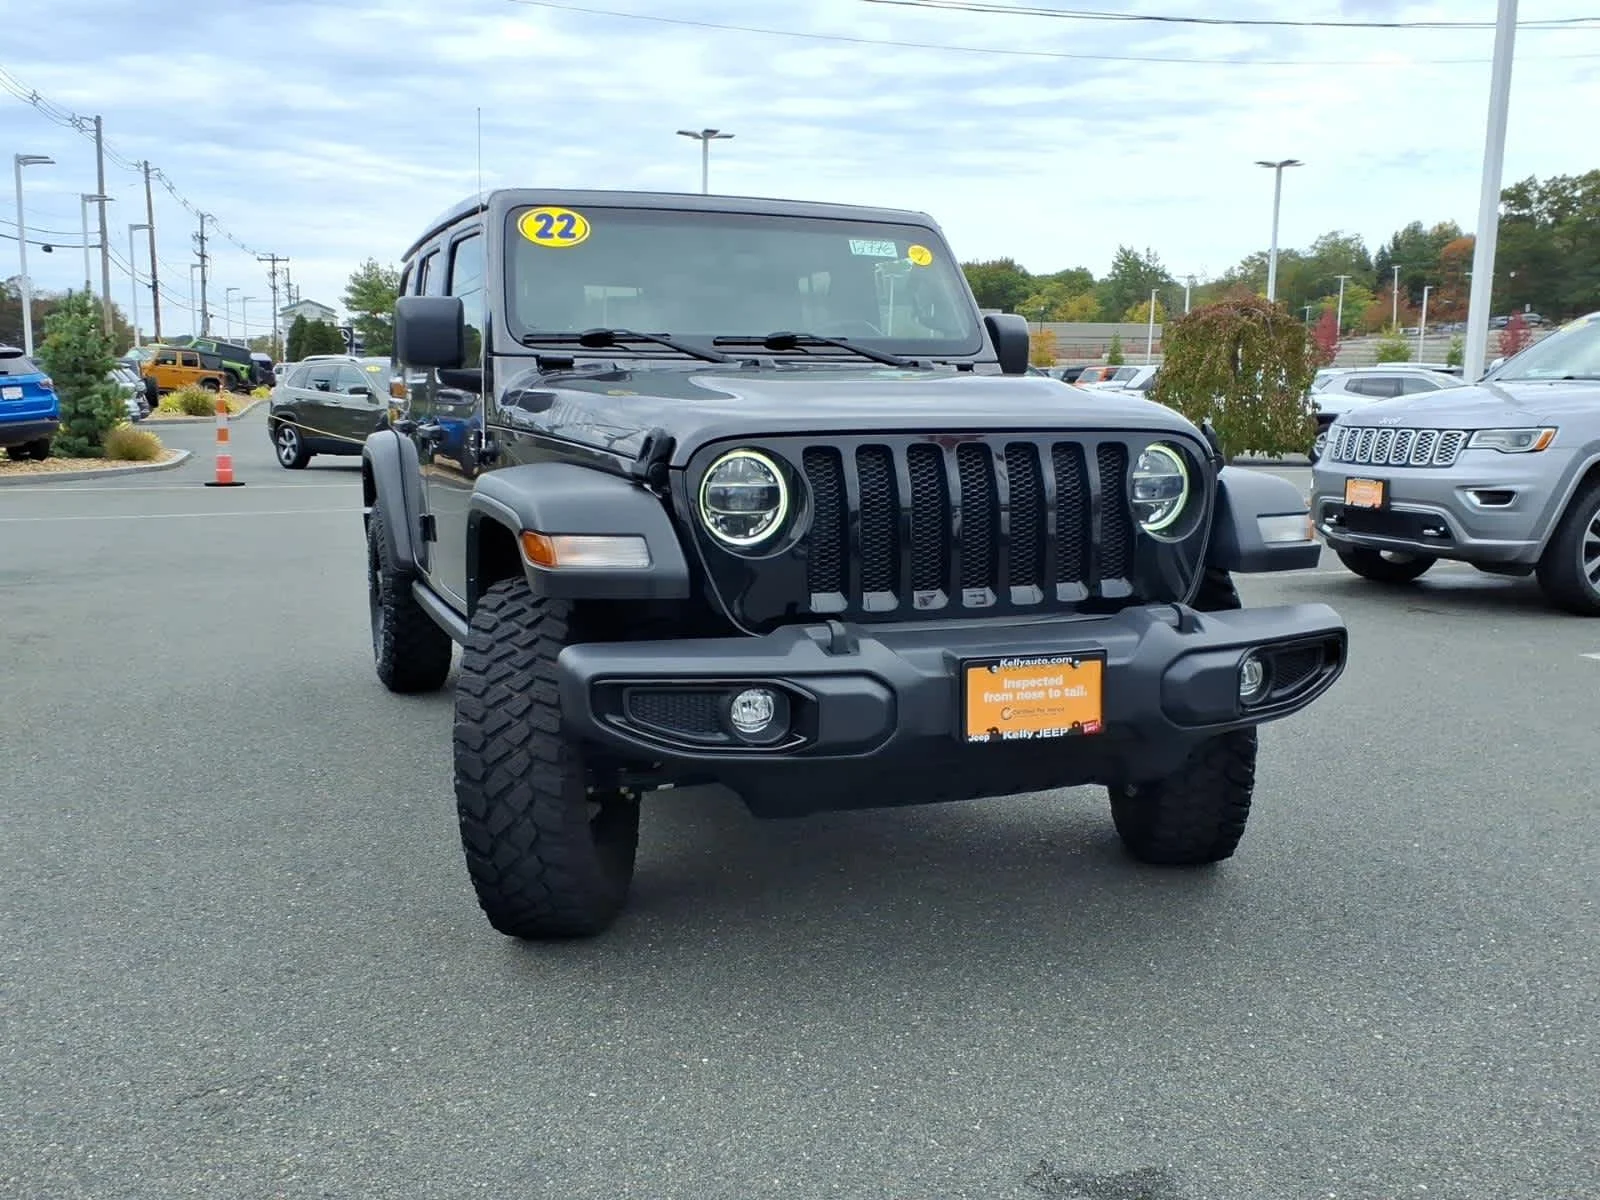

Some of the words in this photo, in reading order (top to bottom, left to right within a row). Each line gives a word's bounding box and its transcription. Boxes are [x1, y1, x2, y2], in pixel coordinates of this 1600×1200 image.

[535, 213, 577, 239] 22
[999, 656, 1073, 668] Kellyauto.com
[1003, 675, 1064, 690] Inspected
[983, 691, 1013, 703] from
[1016, 689, 1045, 701] nose
[1048, 688, 1061, 699] to
[1064, 686, 1087, 697] tail.
[1002, 728, 1034, 741] Kelly
[1035, 727, 1069, 738] JEEP
